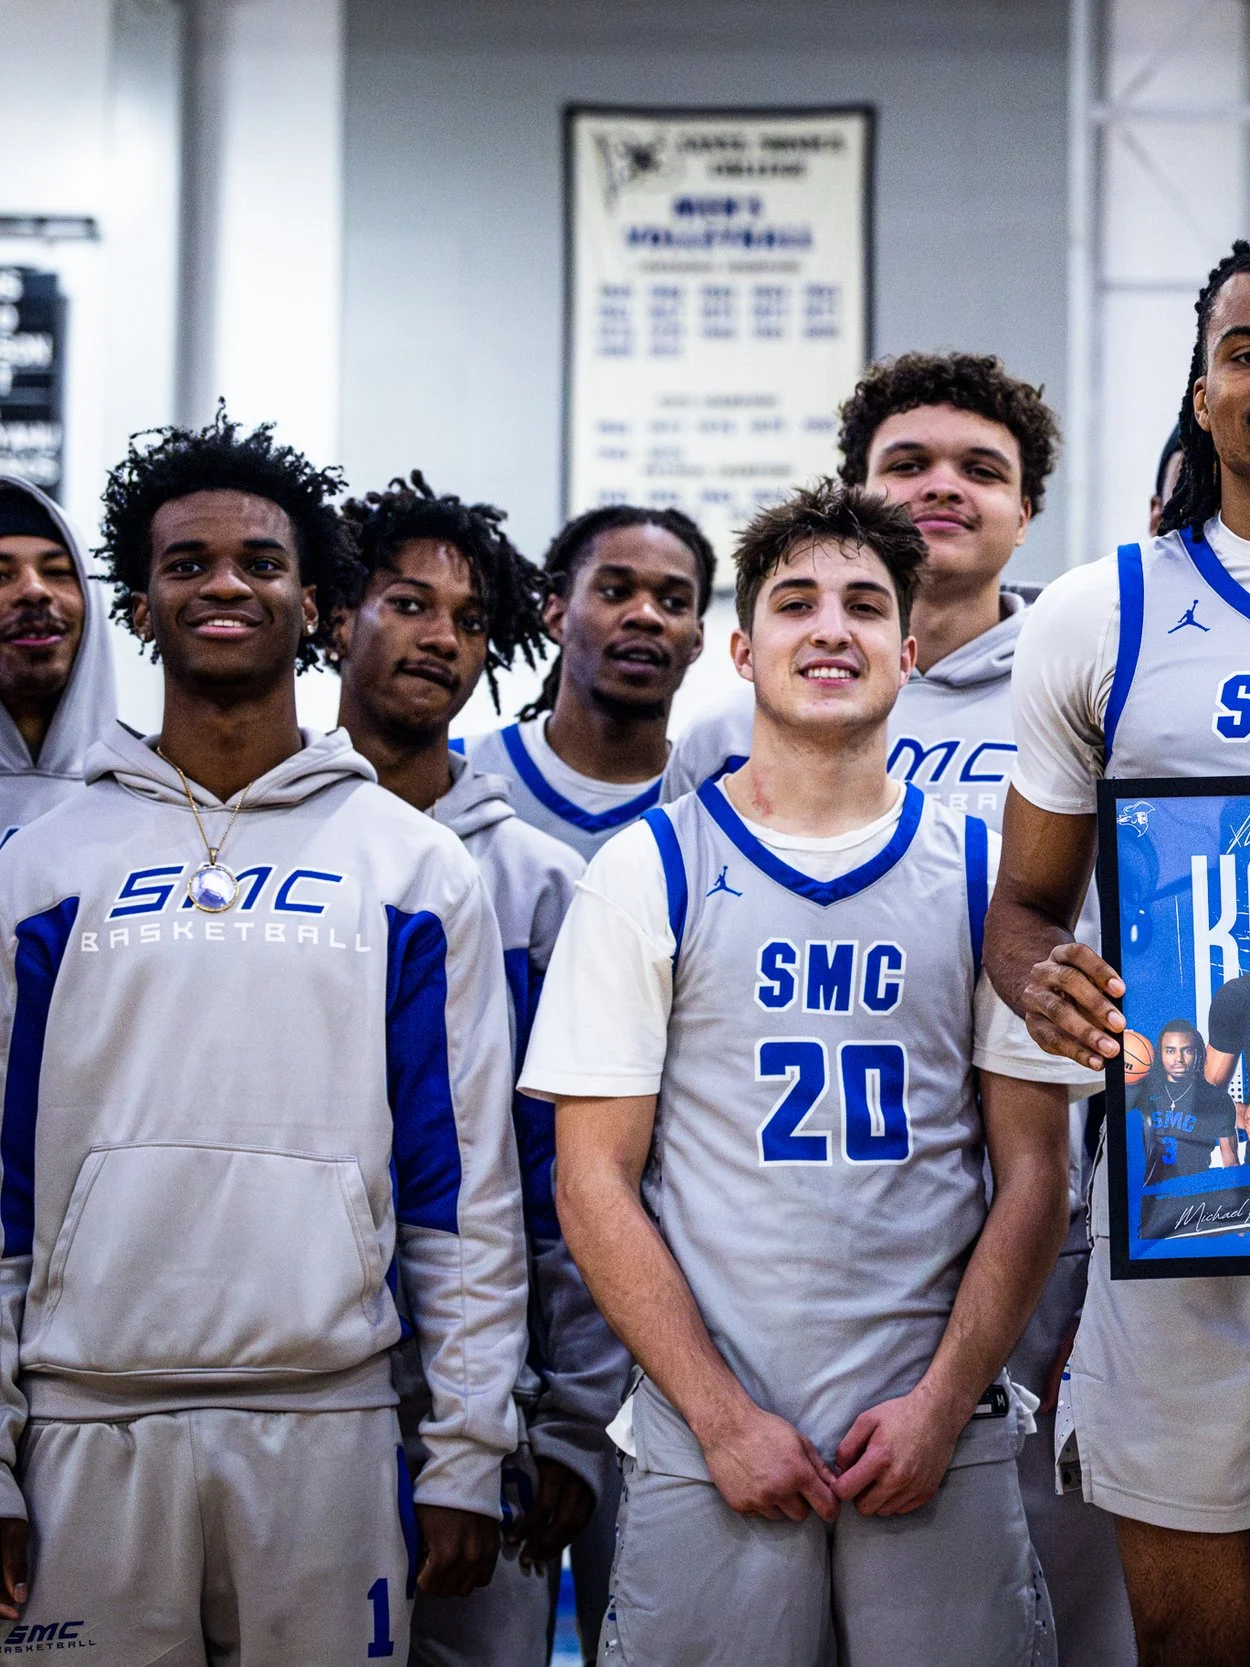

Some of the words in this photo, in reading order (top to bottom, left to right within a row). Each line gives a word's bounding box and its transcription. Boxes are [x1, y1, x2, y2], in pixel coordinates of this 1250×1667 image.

[80, 921, 371, 952] BASKETBALL
[754, 937, 907, 1016] SMC
[754, 1036, 914, 1167] 20
[1151, 1110, 1197, 1133] SMC
[1162, 1135, 1177, 1165] 3
[1174, 1198, 1250, 1232] Michael
[4, 1621, 84, 1644] SMC
[367, 1577, 395, 1658] 1
[0, 1639, 96, 1654] ASKETBALL
